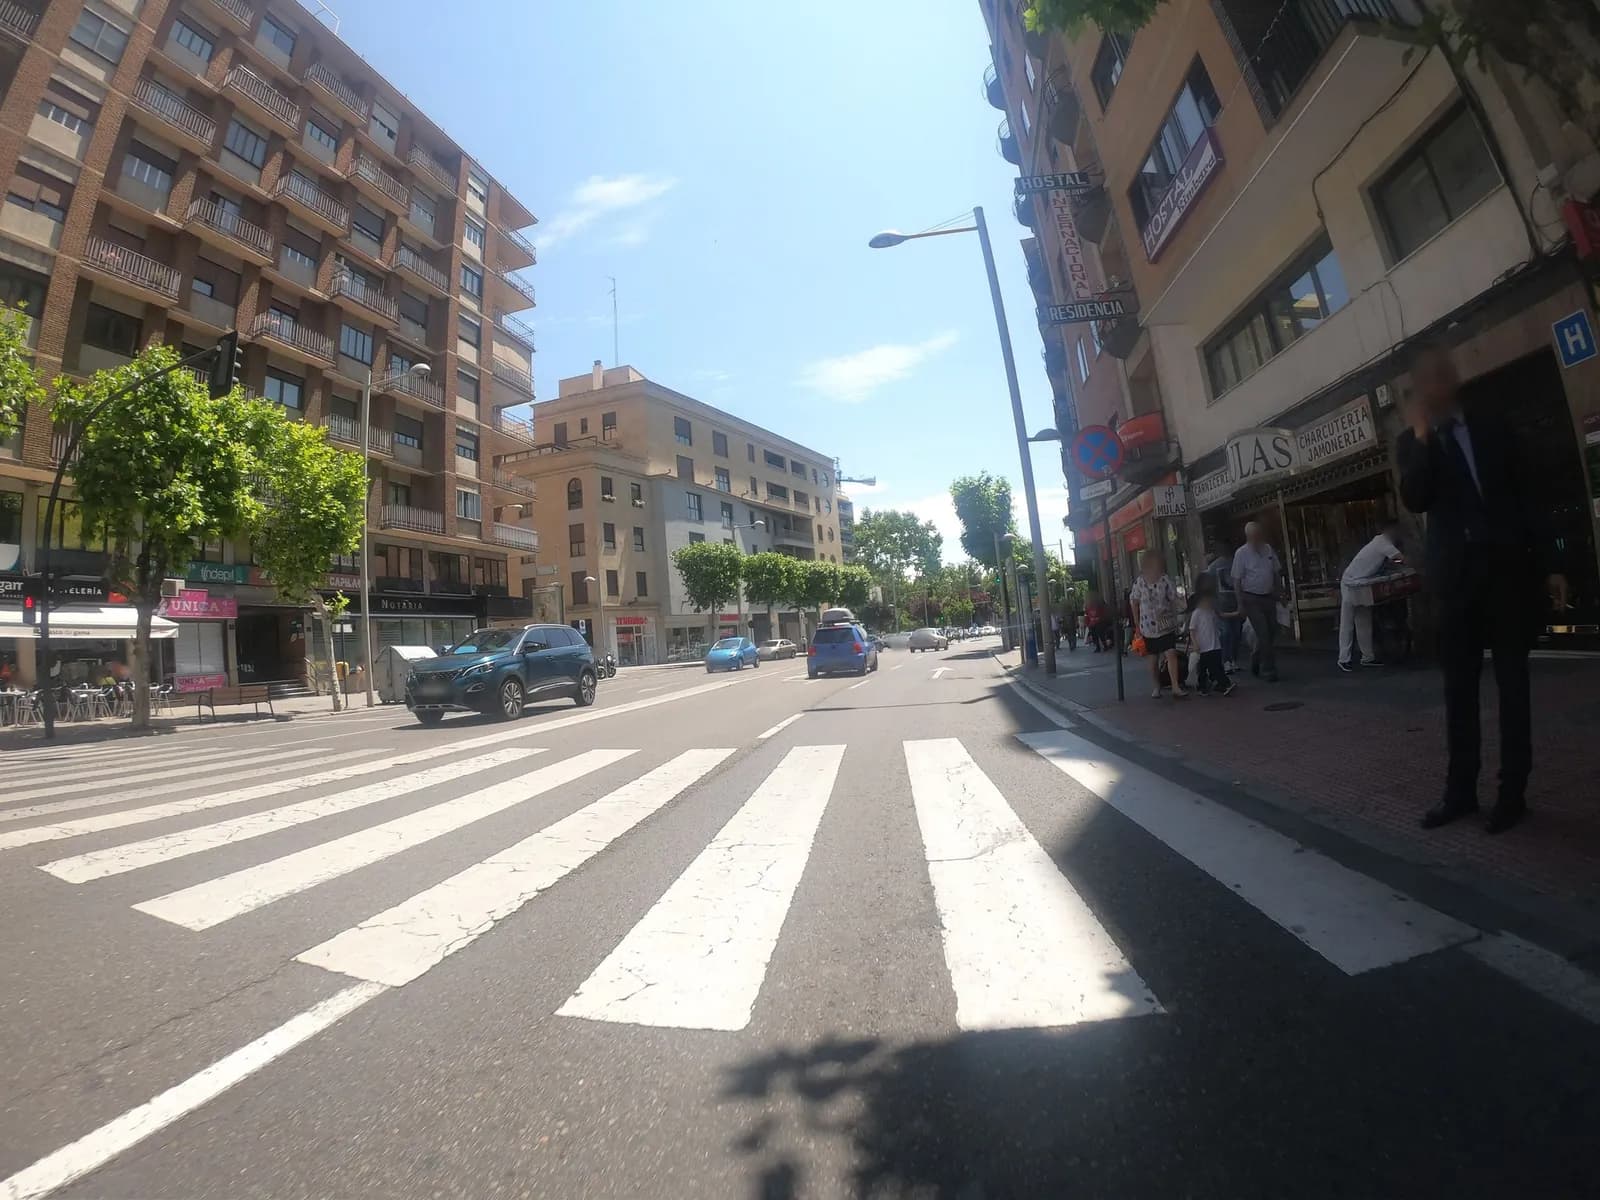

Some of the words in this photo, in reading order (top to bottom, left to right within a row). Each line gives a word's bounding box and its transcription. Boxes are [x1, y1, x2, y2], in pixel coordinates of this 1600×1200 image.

[1021, 173, 1088, 190] HOSTAL
[1144, 167, 1193, 254] HOSTAL
[1050, 301, 1125, 321] RESIDENCIA
[1300, 406, 1369, 449] CHARCUTERIA
[1307, 426, 1366, 462] JAMONERIA
[1193, 471, 1230, 497] CARNICERI
[1157, 503, 1186, 515] MULAS
[329, 576, 361, 589] CAPILA
[171, 600, 221, 613] UNICA
